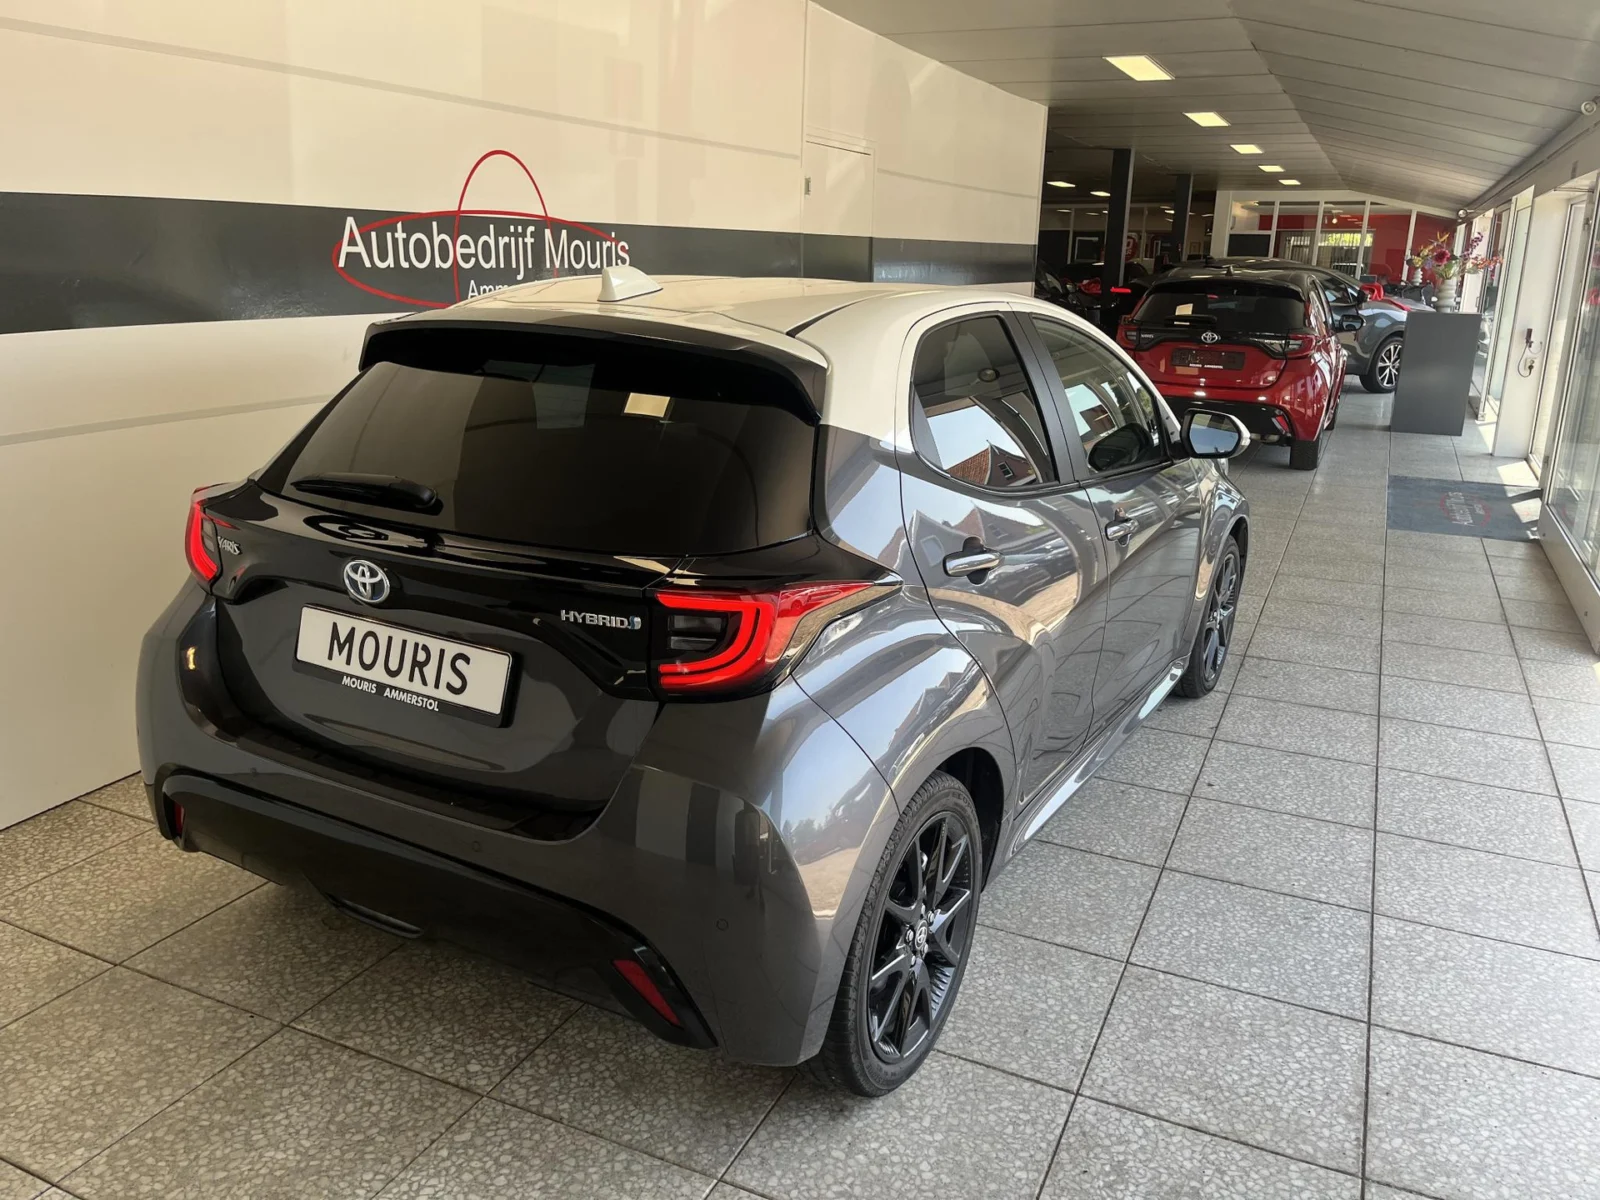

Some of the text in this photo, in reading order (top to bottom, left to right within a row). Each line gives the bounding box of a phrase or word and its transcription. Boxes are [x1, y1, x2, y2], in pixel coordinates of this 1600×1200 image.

[338, 216, 630, 280] Autobedrijf Mouris
[217, 536, 241, 555] YARIS
[560, 609, 629, 629] HYBRID
[327, 621, 472, 696] MOURIS
[341, 675, 439, 712] MOURIS AMMERSTOL
